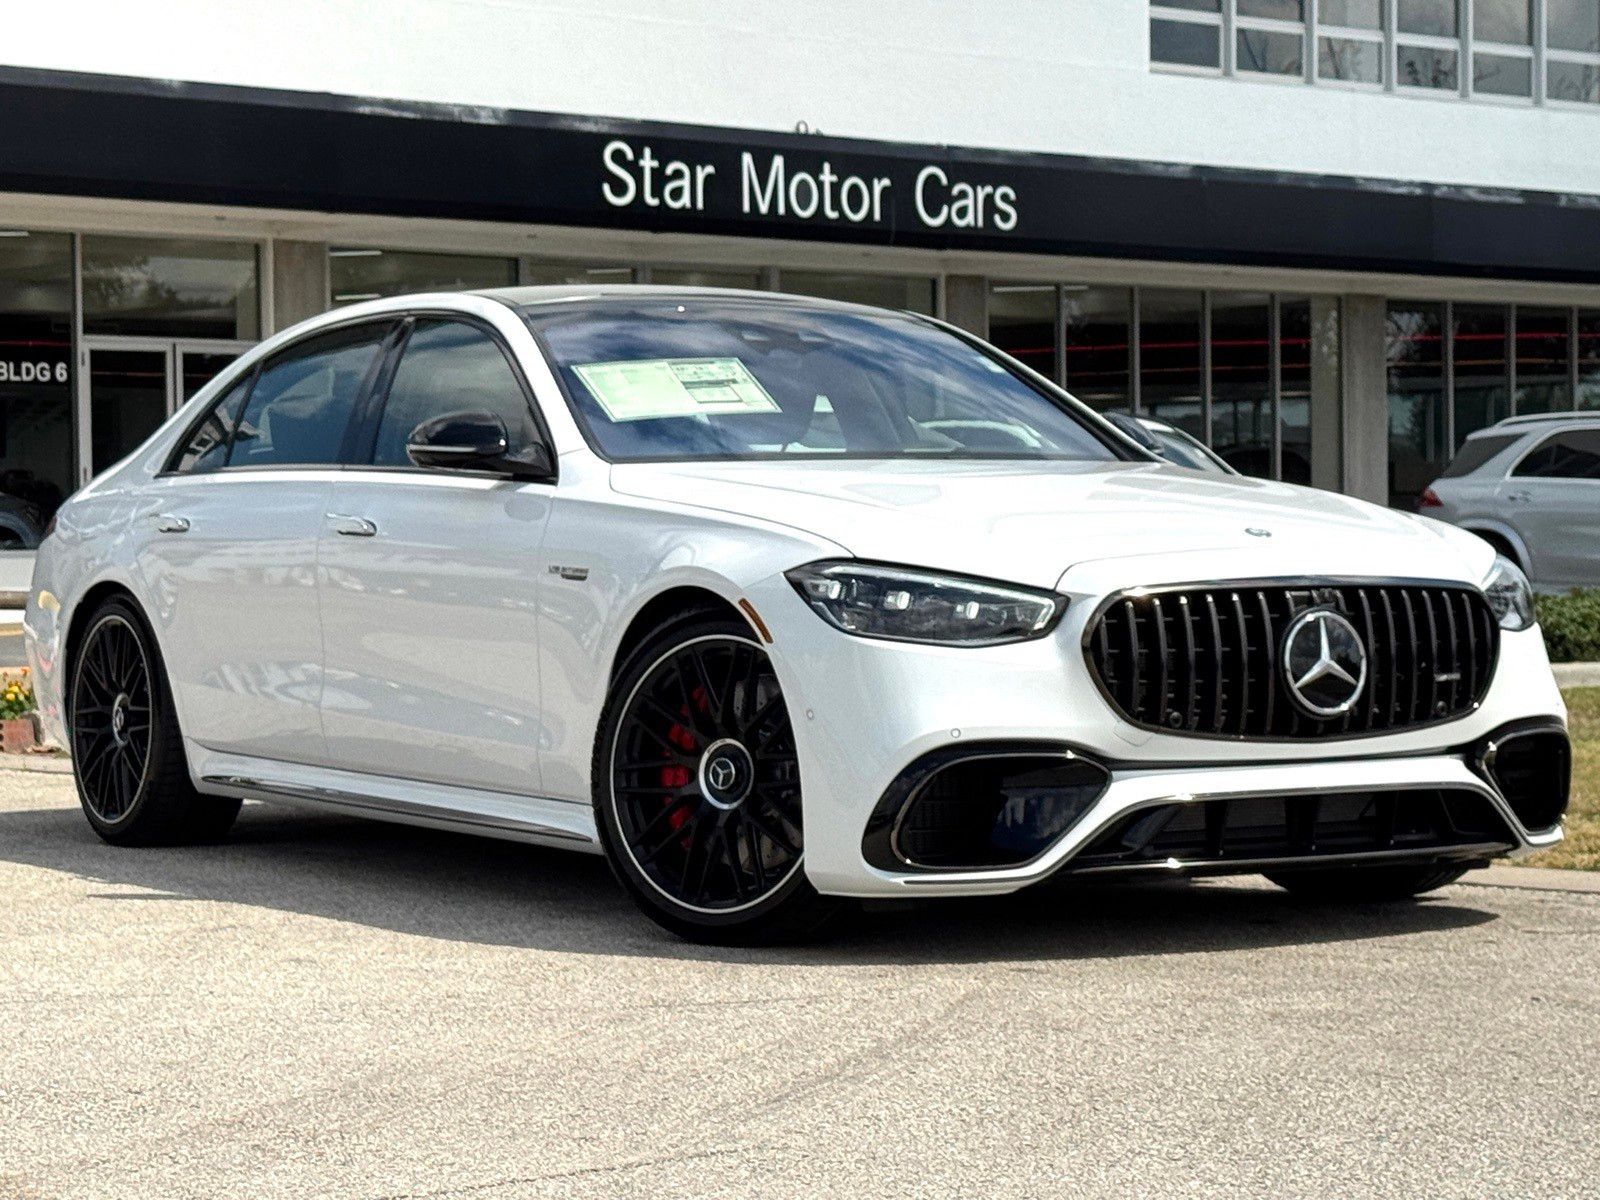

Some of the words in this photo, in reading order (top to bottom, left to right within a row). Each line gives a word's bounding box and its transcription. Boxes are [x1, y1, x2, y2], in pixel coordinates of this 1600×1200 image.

[602, 140, 715, 210] Star
[741, 151, 891, 222] Motor
[915, 165, 1018, 231] Cars
[0, 361, 51, 382] BLDG
[55, 361, 68, 382] 6
